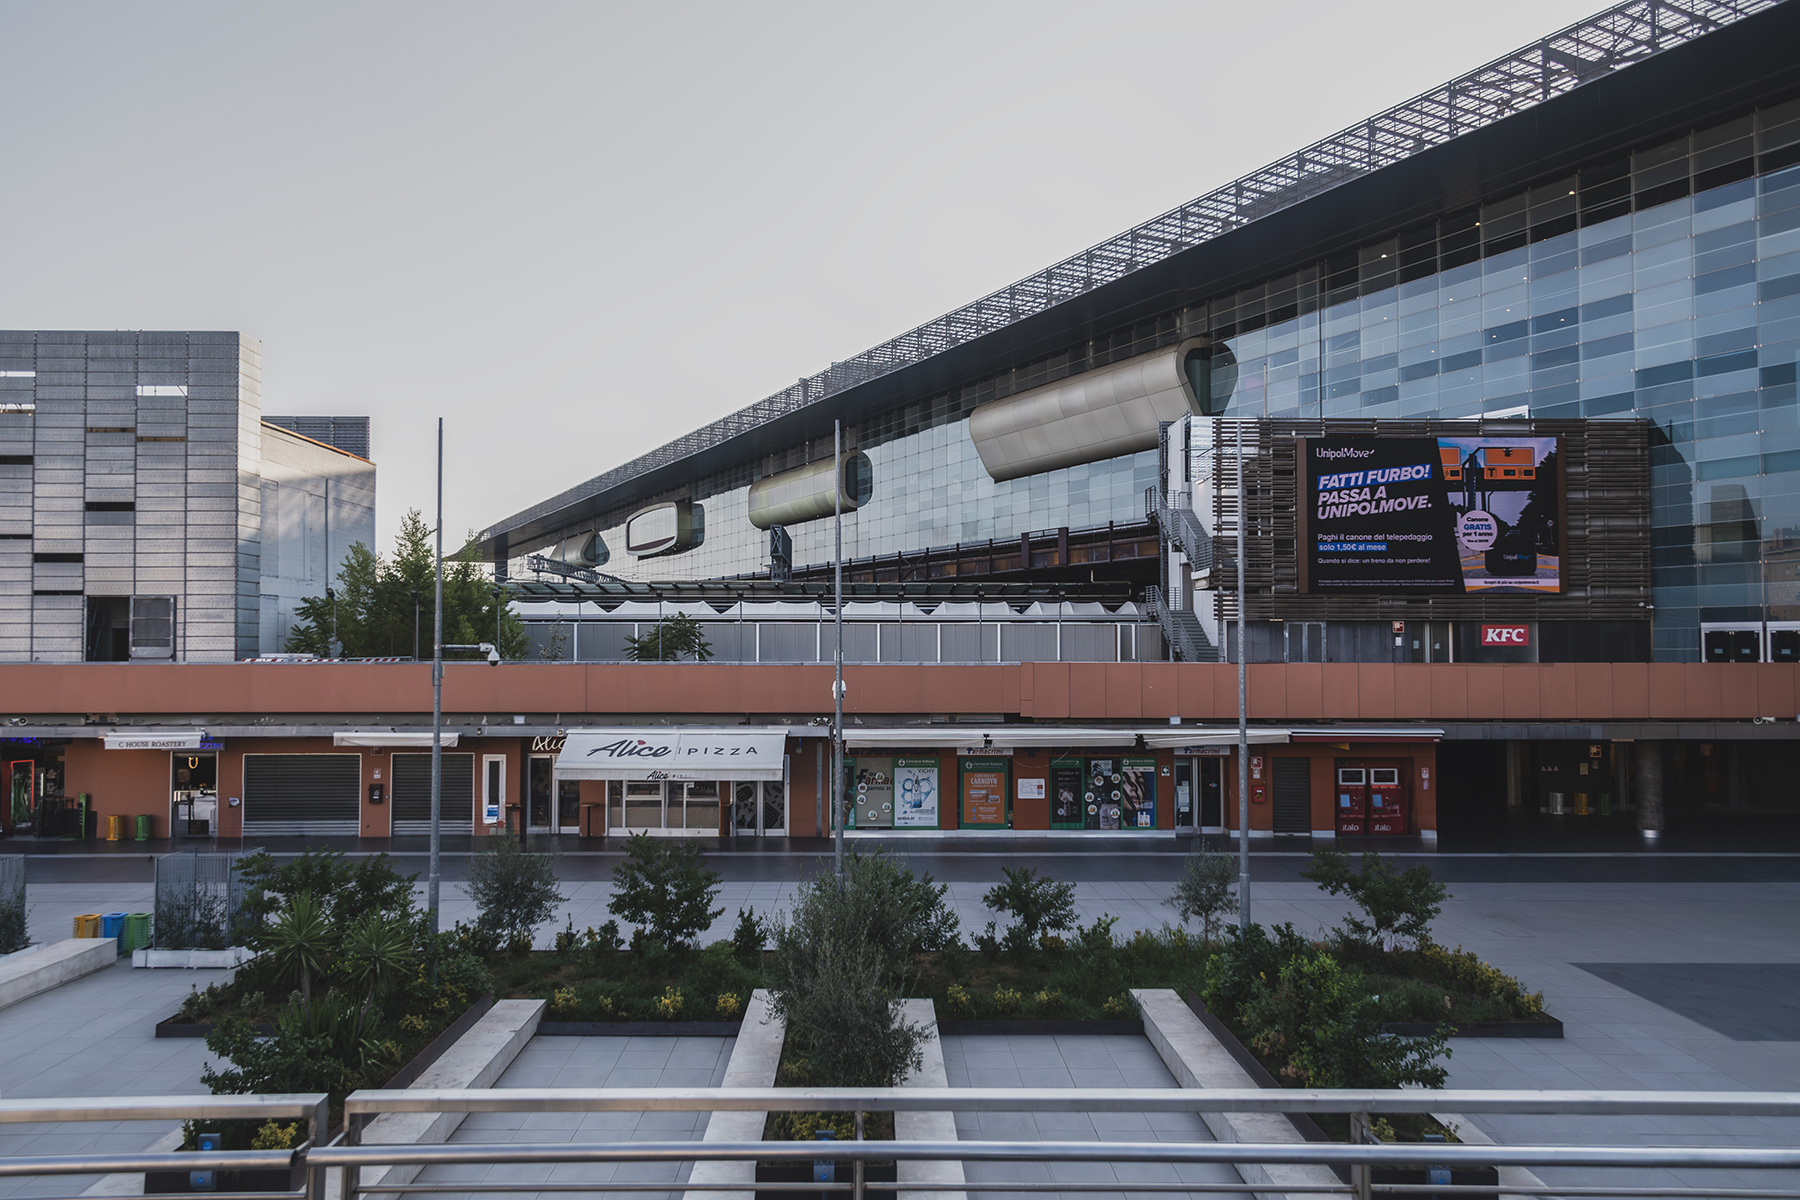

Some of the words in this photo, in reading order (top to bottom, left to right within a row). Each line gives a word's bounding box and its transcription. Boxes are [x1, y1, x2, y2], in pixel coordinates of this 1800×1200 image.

[1316, 447, 1375, 461] UnipolMove
[1319, 472, 1364, 490] FATTI
[1366, 465, 1431, 484] FURBO!
[1317, 487, 1371, 506] PASSA
[1373, 485, 1387, 500] A
[1317, 495, 1433, 520] UNIPOLMOVE.
[1463, 523, 1492, 531] GRATIS
[1317, 534, 1338, 542] Paghi
[1374, 533, 1386, 541] del
[1386, 533, 1433, 543] telepedaggio
[1336, 544, 1357, 552] 1,50€
[1485, 628, 1526, 642] KFC
[151, 740, 187, 748] ROASTERY
[532, 736, 567, 751] Alic
[586, 739, 672, 758] Alice
[688, 746, 758, 756] PIZZA
[647, 770, 669, 781] Alice
